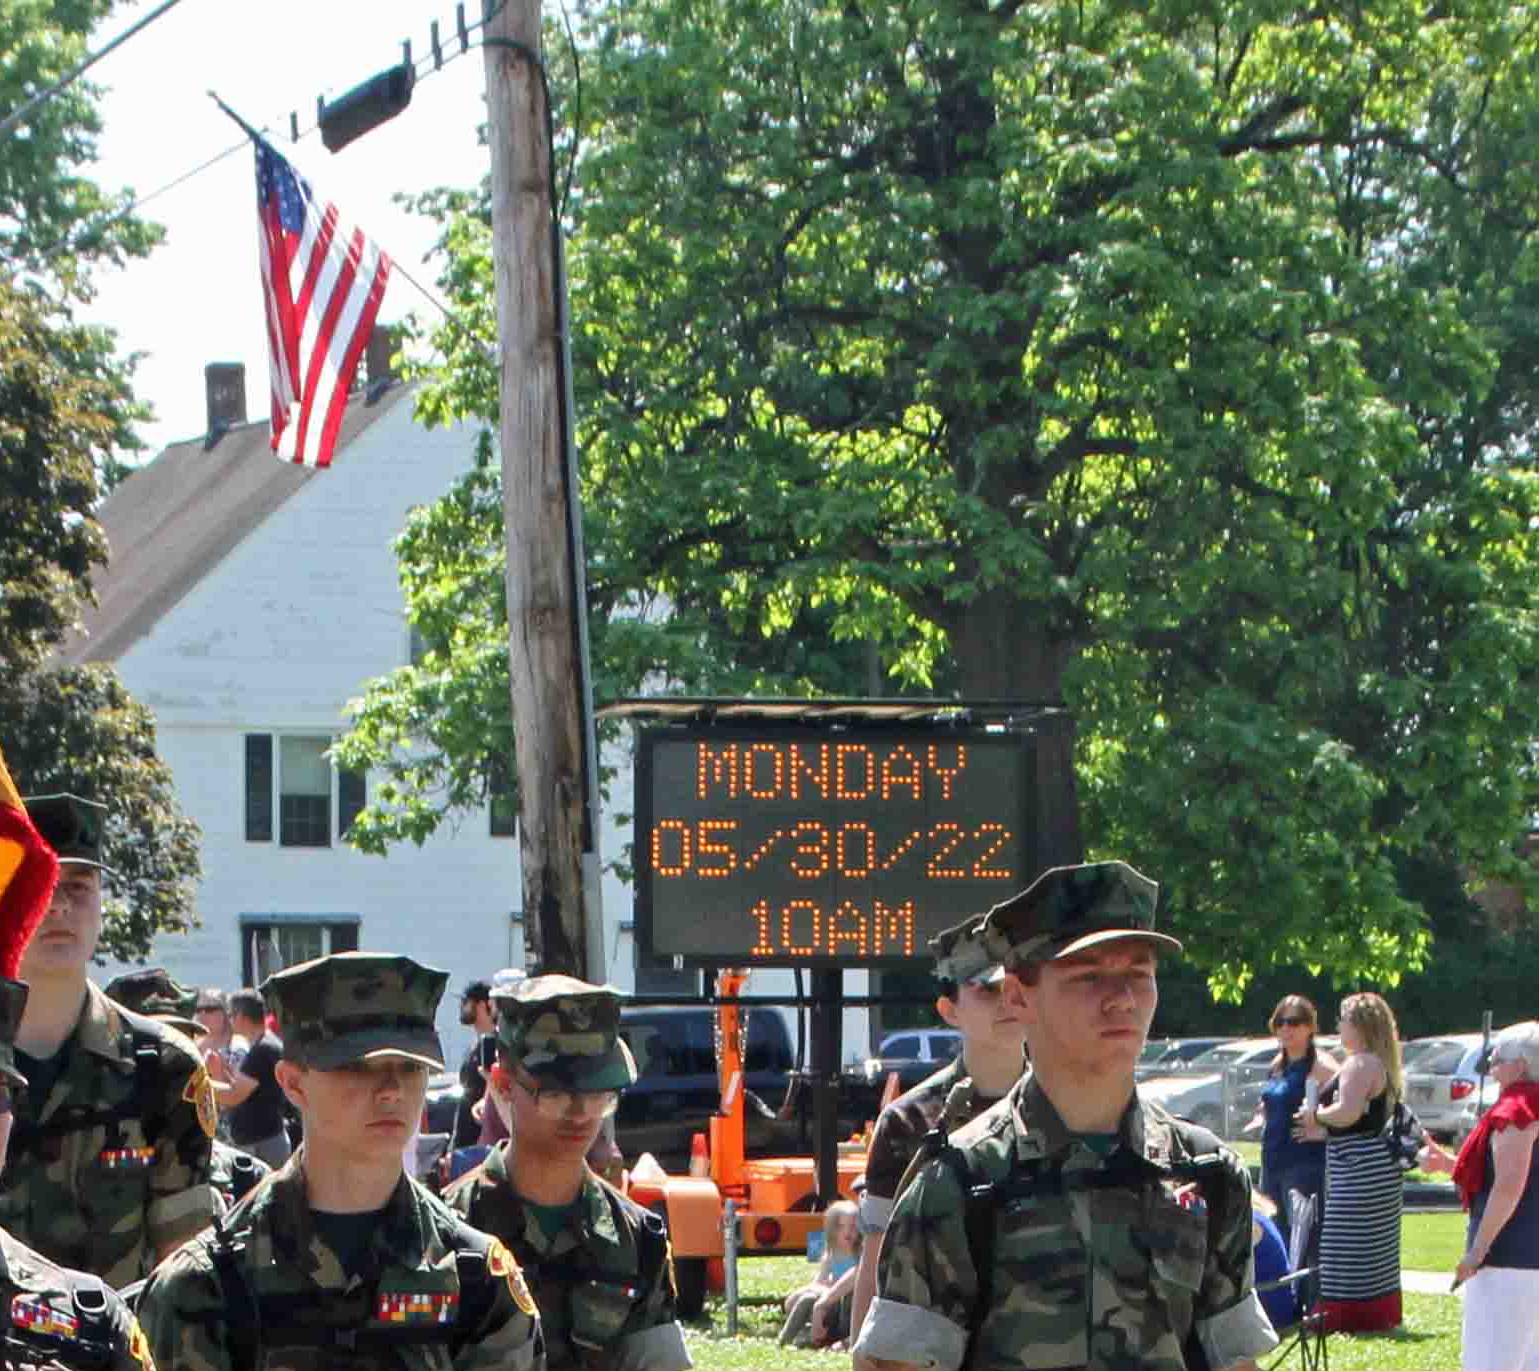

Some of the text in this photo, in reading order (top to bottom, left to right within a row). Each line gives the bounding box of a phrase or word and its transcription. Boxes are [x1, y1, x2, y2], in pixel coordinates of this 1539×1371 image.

[697, 742, 968, 800] MONDAY
[651, 820, 1013, 879] 05/30/22
[749, 900, 915, 957] 10AM
